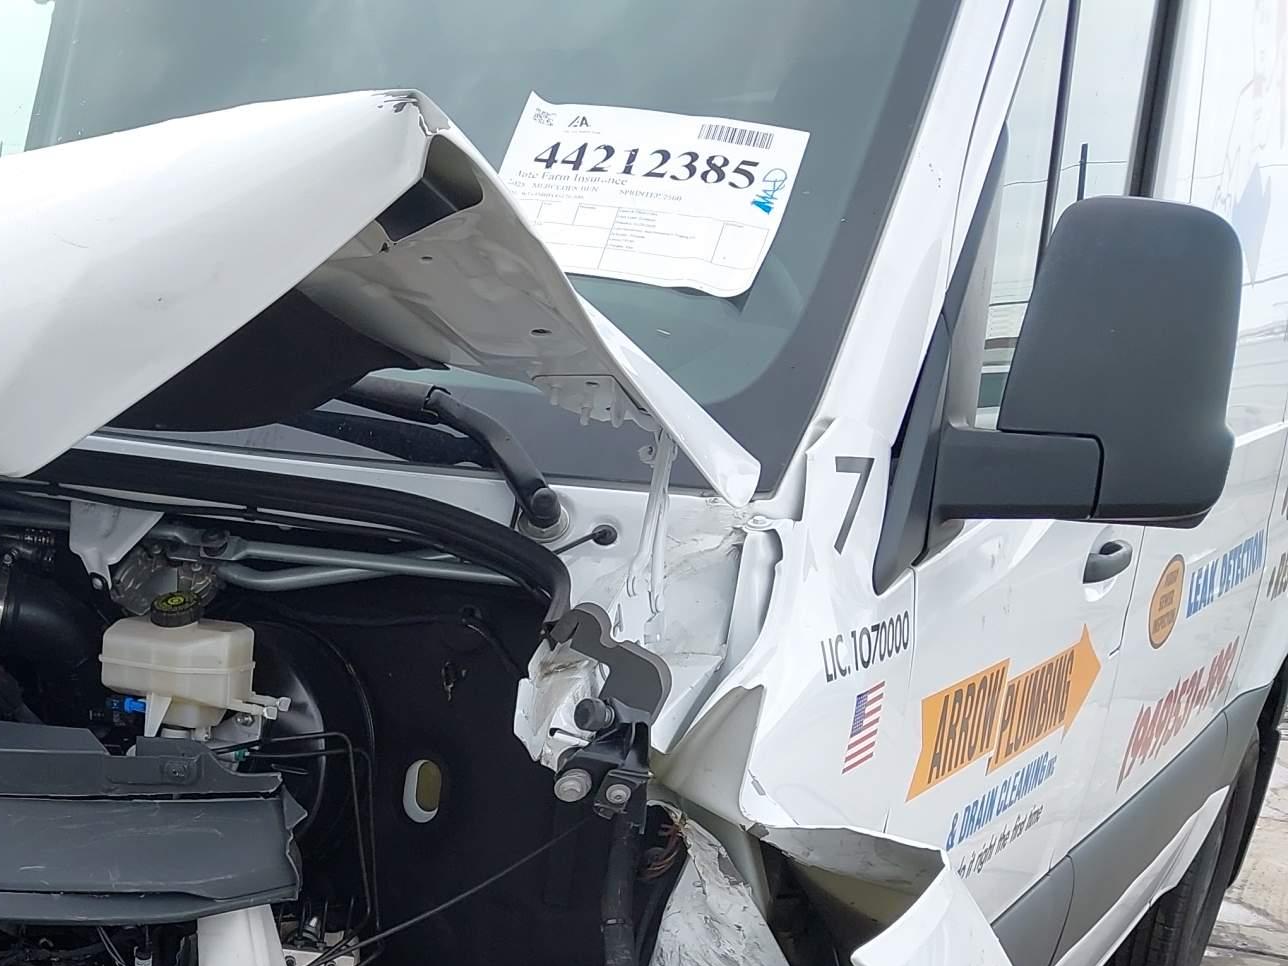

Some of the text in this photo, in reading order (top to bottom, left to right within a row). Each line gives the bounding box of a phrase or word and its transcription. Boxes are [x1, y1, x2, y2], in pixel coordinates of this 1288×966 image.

[518, 169, 539, 180] tate
[541, 171, 570, 182] Farm
[533, 142, 760, 190] 44212385
[833, 456, 876, 556] 7
[1186, 558, 1219, 619] LEAK
[1217, 530, 1264, 598] DETECTION
[928, 648, 1075, 785] ARROW PLUMBING
[945, 811, 959, 850] &
[958, 785, 998, 845] DRAIN
[996, 751, 1049, 817] CLEANING
[974, 834, 996, 874] right
[994, 824, 1010, 856] the
